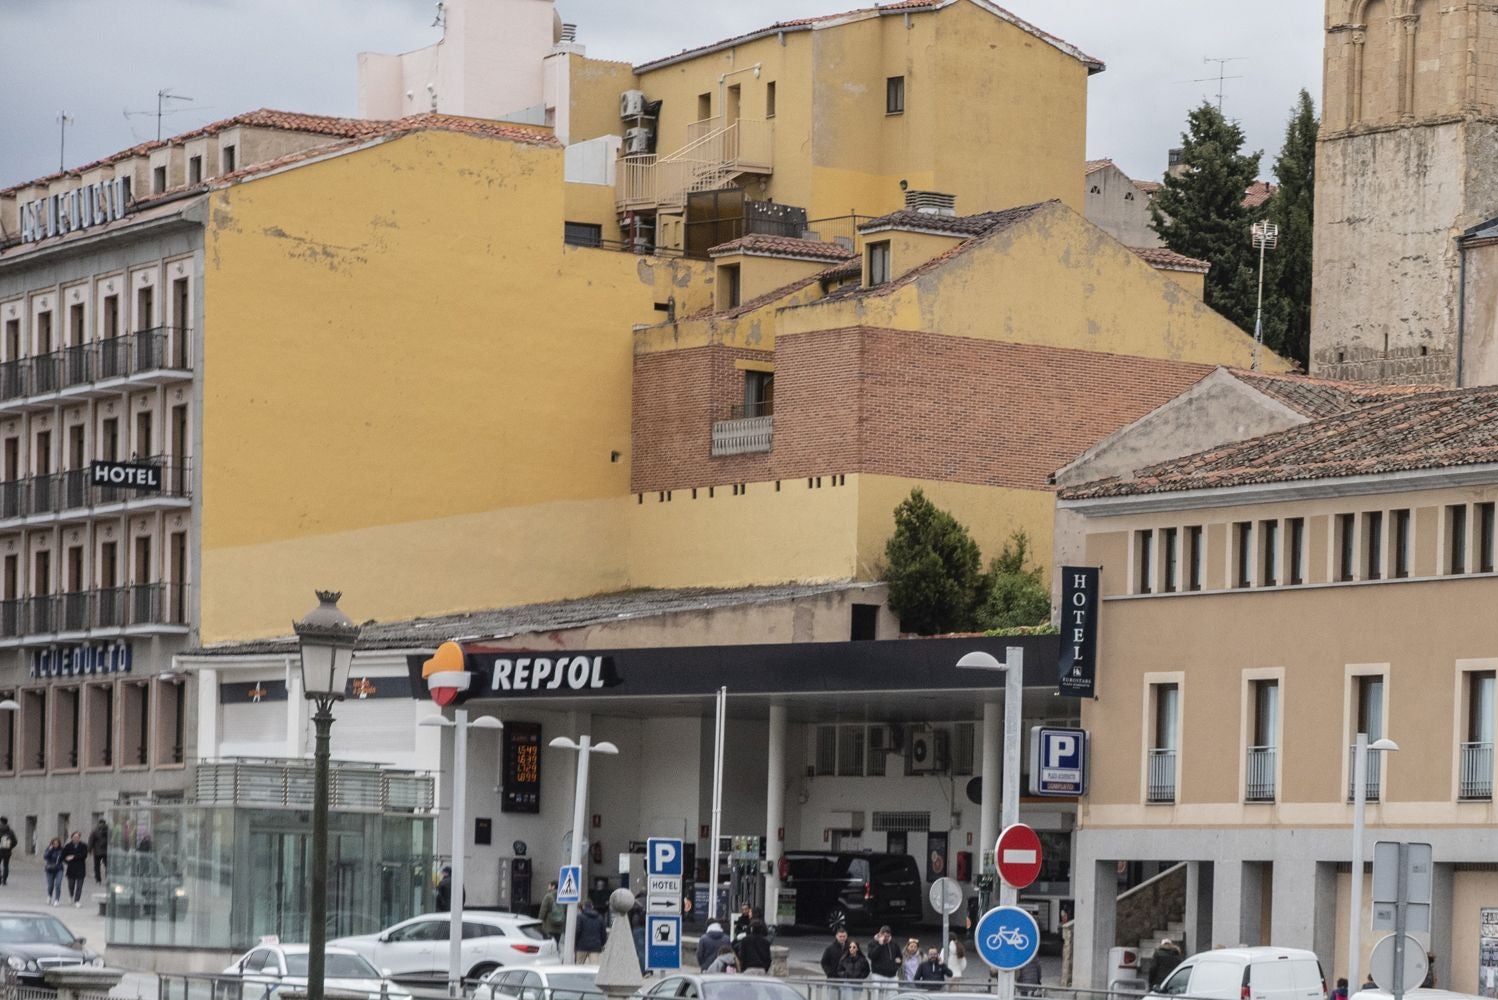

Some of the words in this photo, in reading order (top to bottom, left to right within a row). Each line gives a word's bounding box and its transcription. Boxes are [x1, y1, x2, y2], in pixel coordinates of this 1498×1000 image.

[21, 176, 125, 243] ACUEDUCTO
[95, 465, 157, 486] HOTEL
[1072, 574, 1087, 661] HOTEL
[31, 644, 127, 678] ACUEDUCTO
[491, 656, 604, 690] REPSOL
[1049, 736, 1075, 767] P
[654, 843, 676, 872] P
[652, 880, 678, 890] HOTEL
